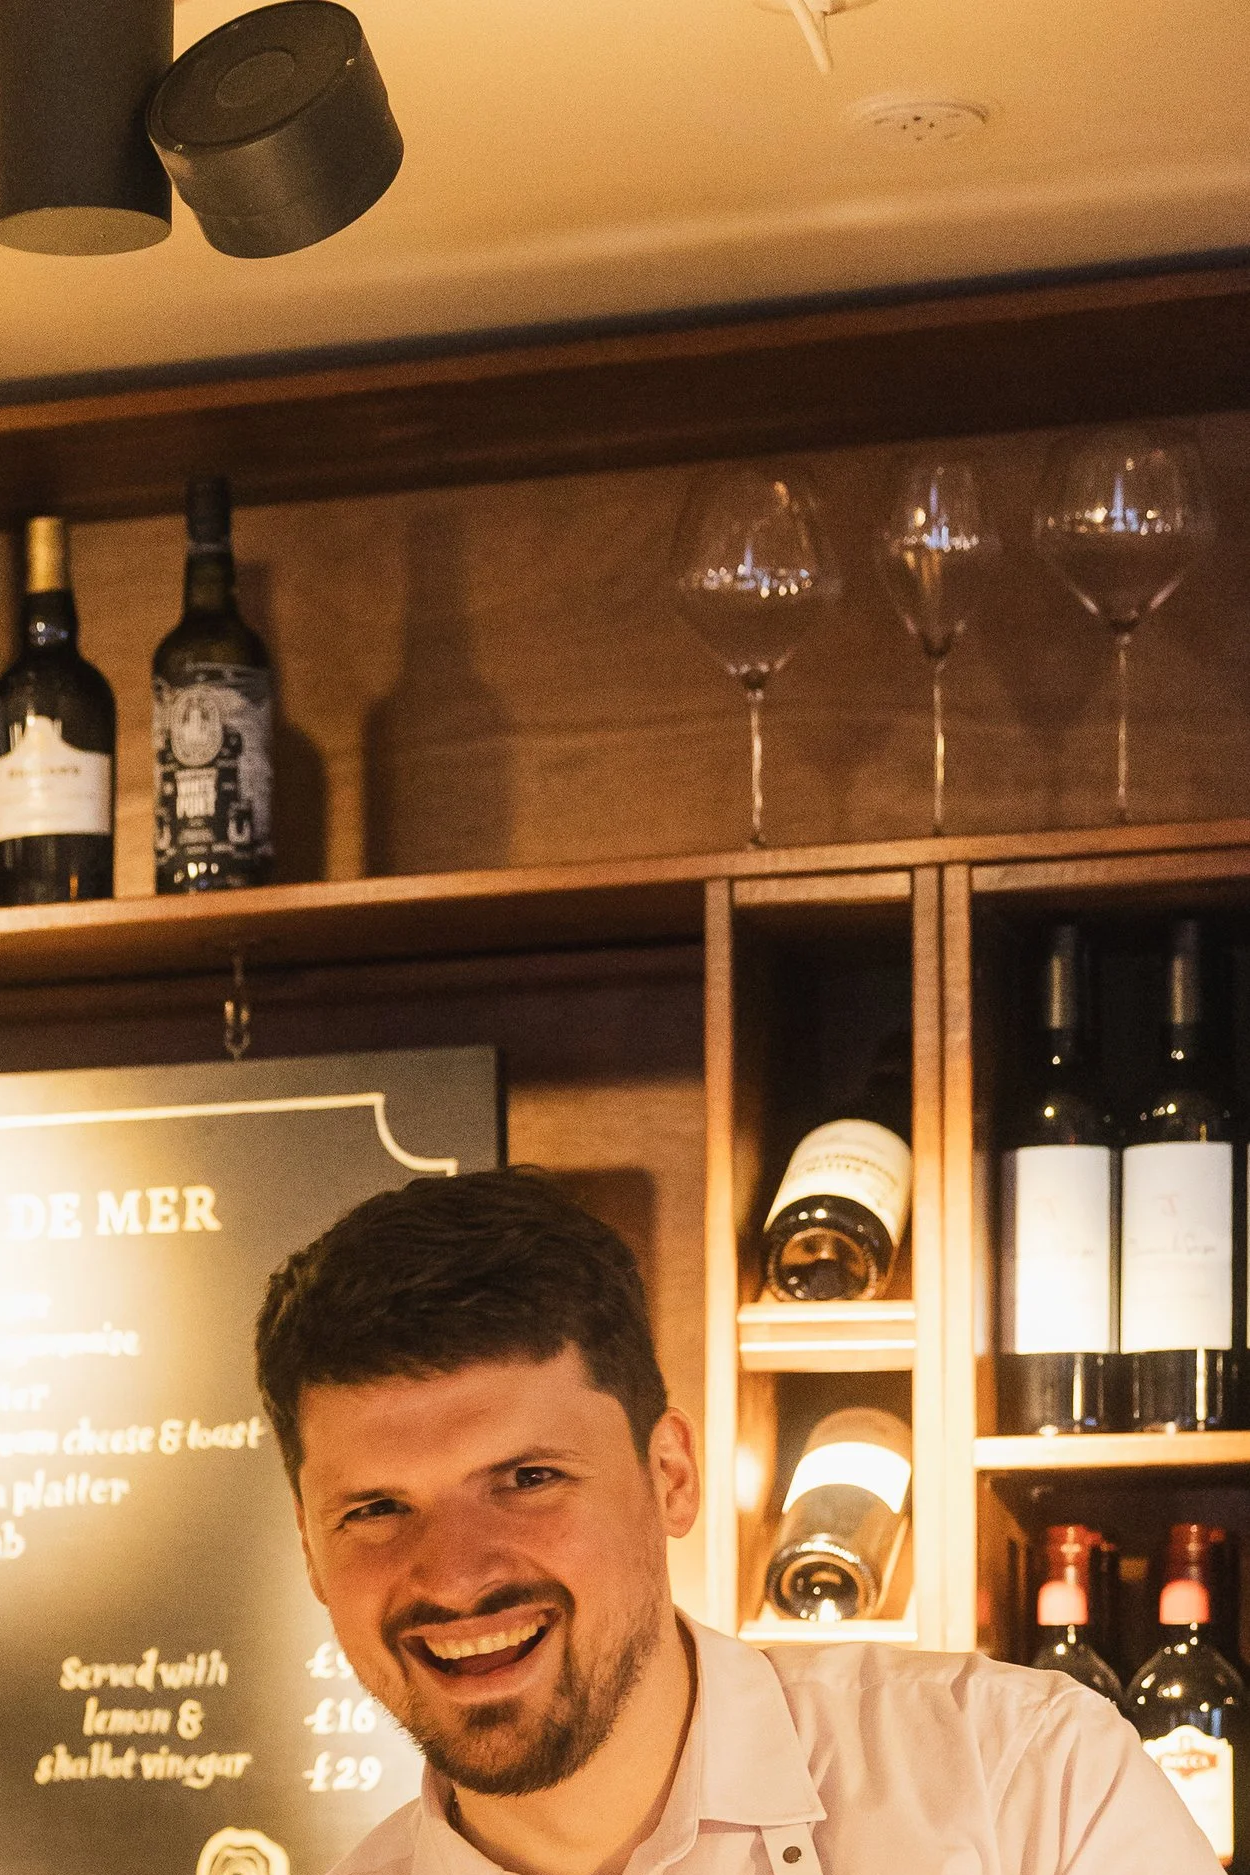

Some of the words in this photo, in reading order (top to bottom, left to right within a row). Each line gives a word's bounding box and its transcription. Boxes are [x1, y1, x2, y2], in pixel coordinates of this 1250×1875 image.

[5, 1192, 82, 1240] DE
[95, 1185, 223, 1236] MER
[62, 1416, 155, 1456] cheese
[186, 1416, 264, 1451] toast
[12, 1467, 131, 1517] platter
[59, 1647, 159, 1692] Served
[156, 1649, 228, 1690] with
[82, 1696, 172, 1737] lemon
[176, 1699, 205, 1741] &
[303, 1697, 377, 1735] £16
[34, 1741, 137, 1786] shallot
[140, 1744, 253, 1790] vinegar
[300, 1751, 382, 1792] £29
